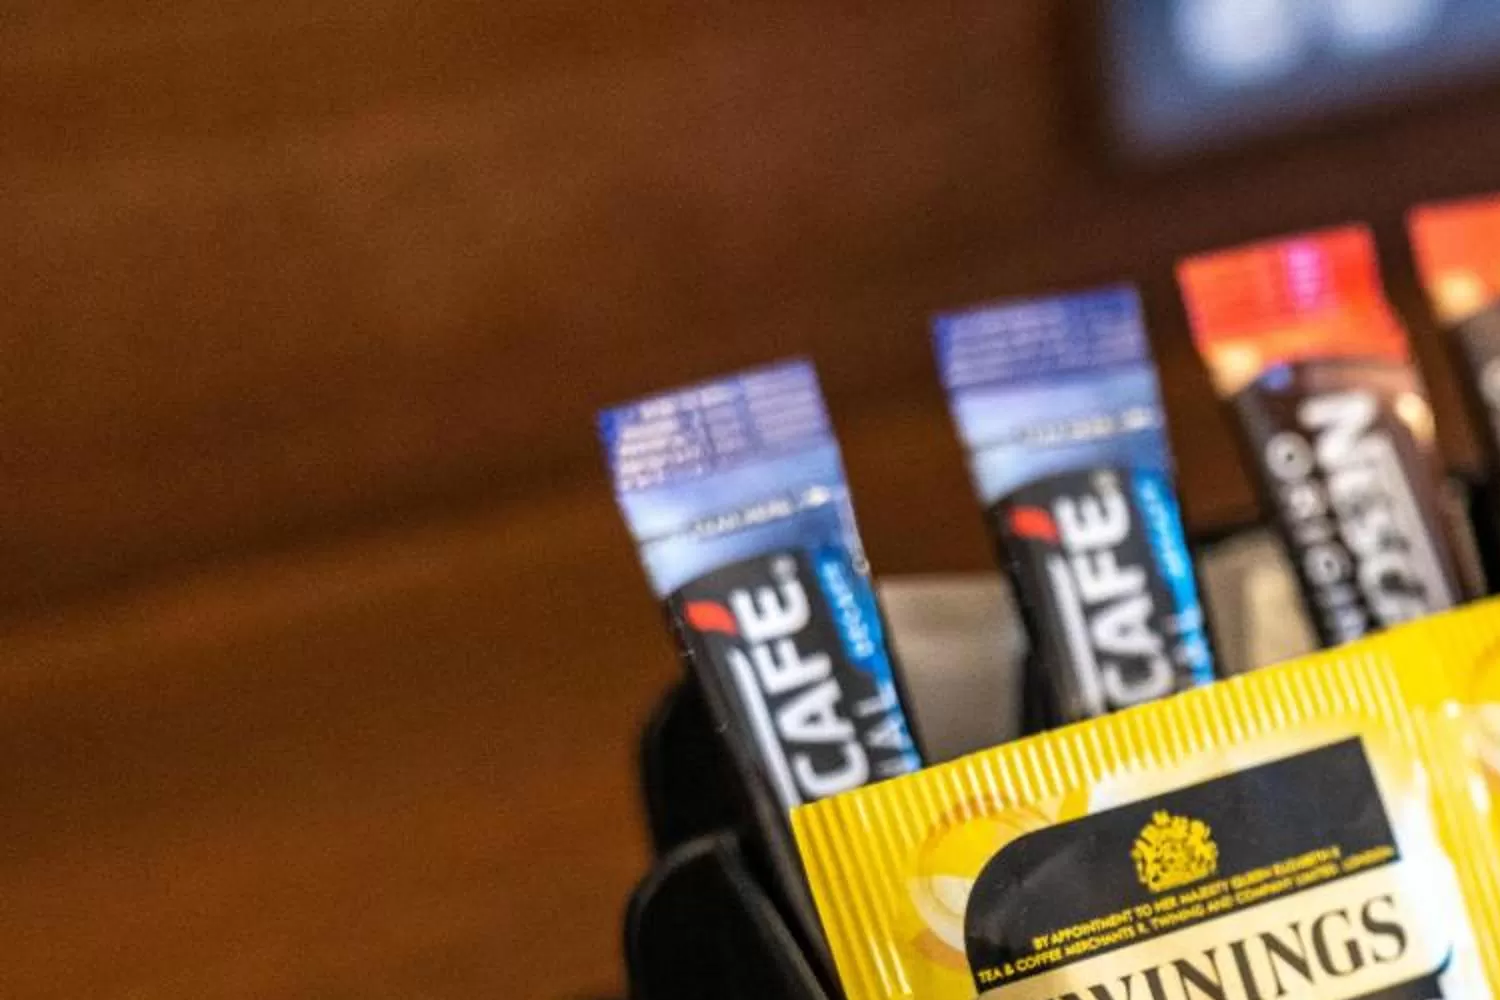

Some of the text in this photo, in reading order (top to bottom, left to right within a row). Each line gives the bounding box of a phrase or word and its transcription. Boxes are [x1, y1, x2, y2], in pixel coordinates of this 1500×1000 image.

[1051, 909, 1133, 945] APPOINTMENT
[1134, 904, 1153, 918] TO
[978, 969, 1001, 984] TEA
[1015, 948, 1063, 972] COFFEE
